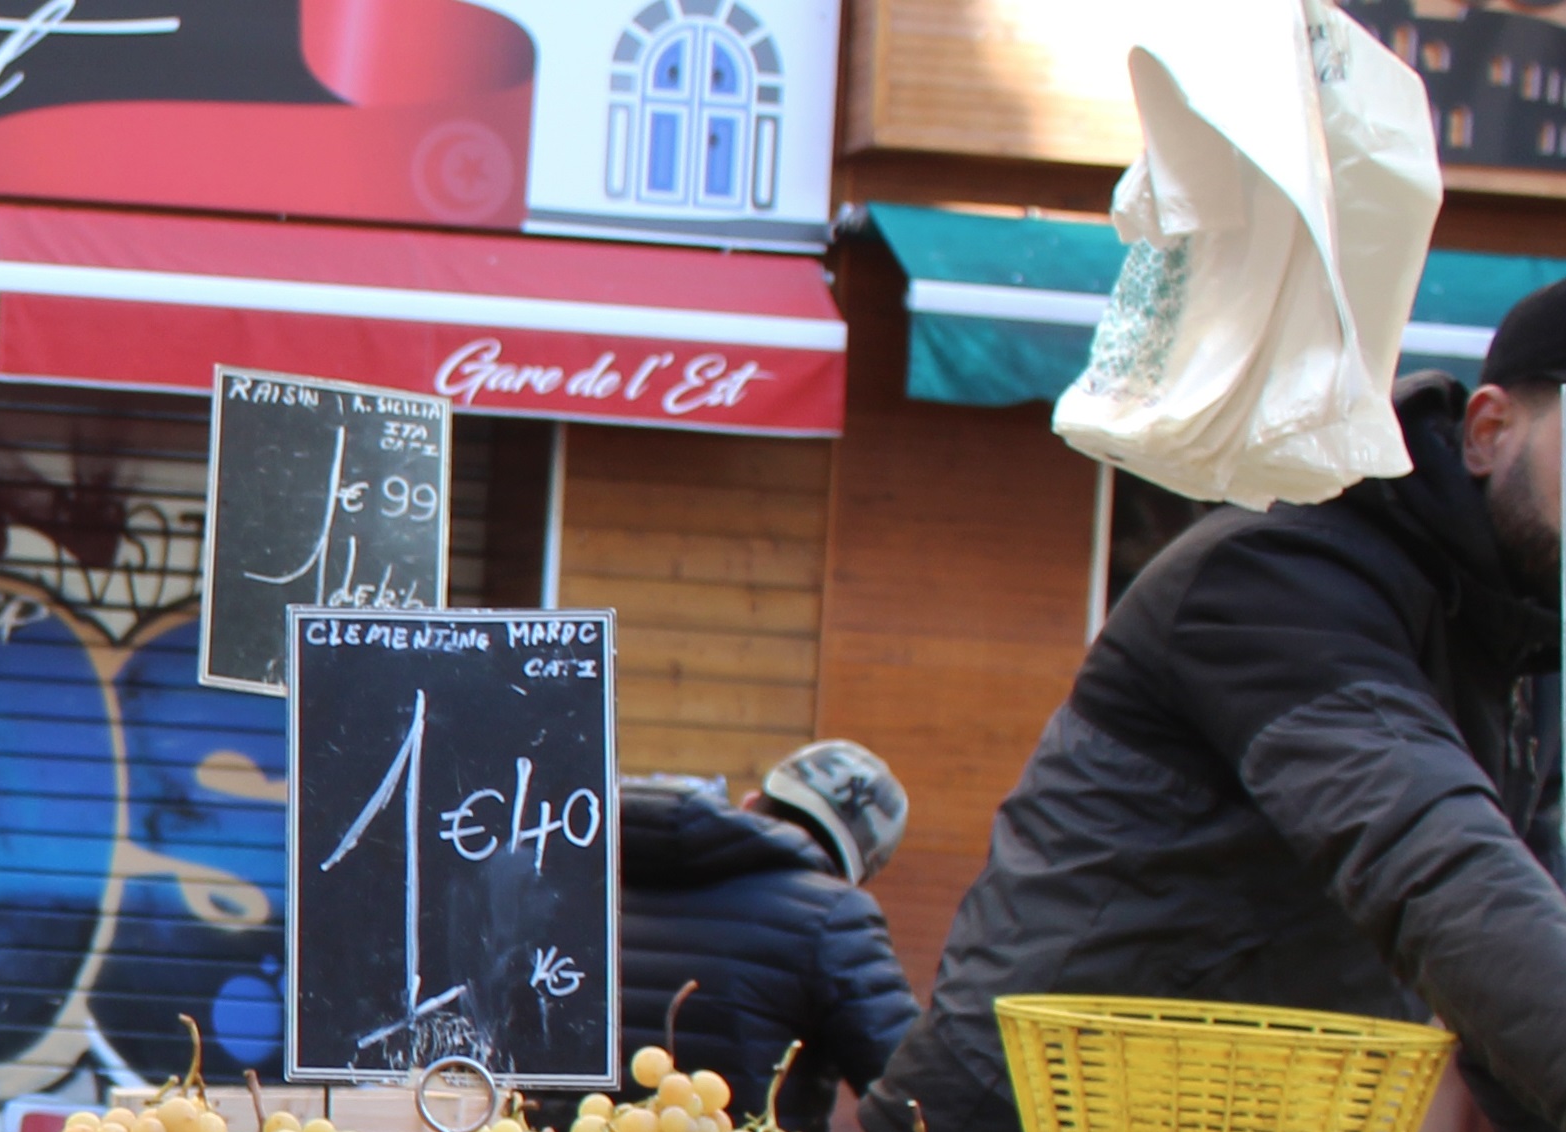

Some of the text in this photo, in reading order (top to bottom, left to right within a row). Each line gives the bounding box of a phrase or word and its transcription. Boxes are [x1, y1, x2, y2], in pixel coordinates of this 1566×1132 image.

[433, 337, 564, 407] Gare
[565, 350, 621, 399] de
[506, 620, 598, 648] MAROC
[529, 945, 586, 997] KG
